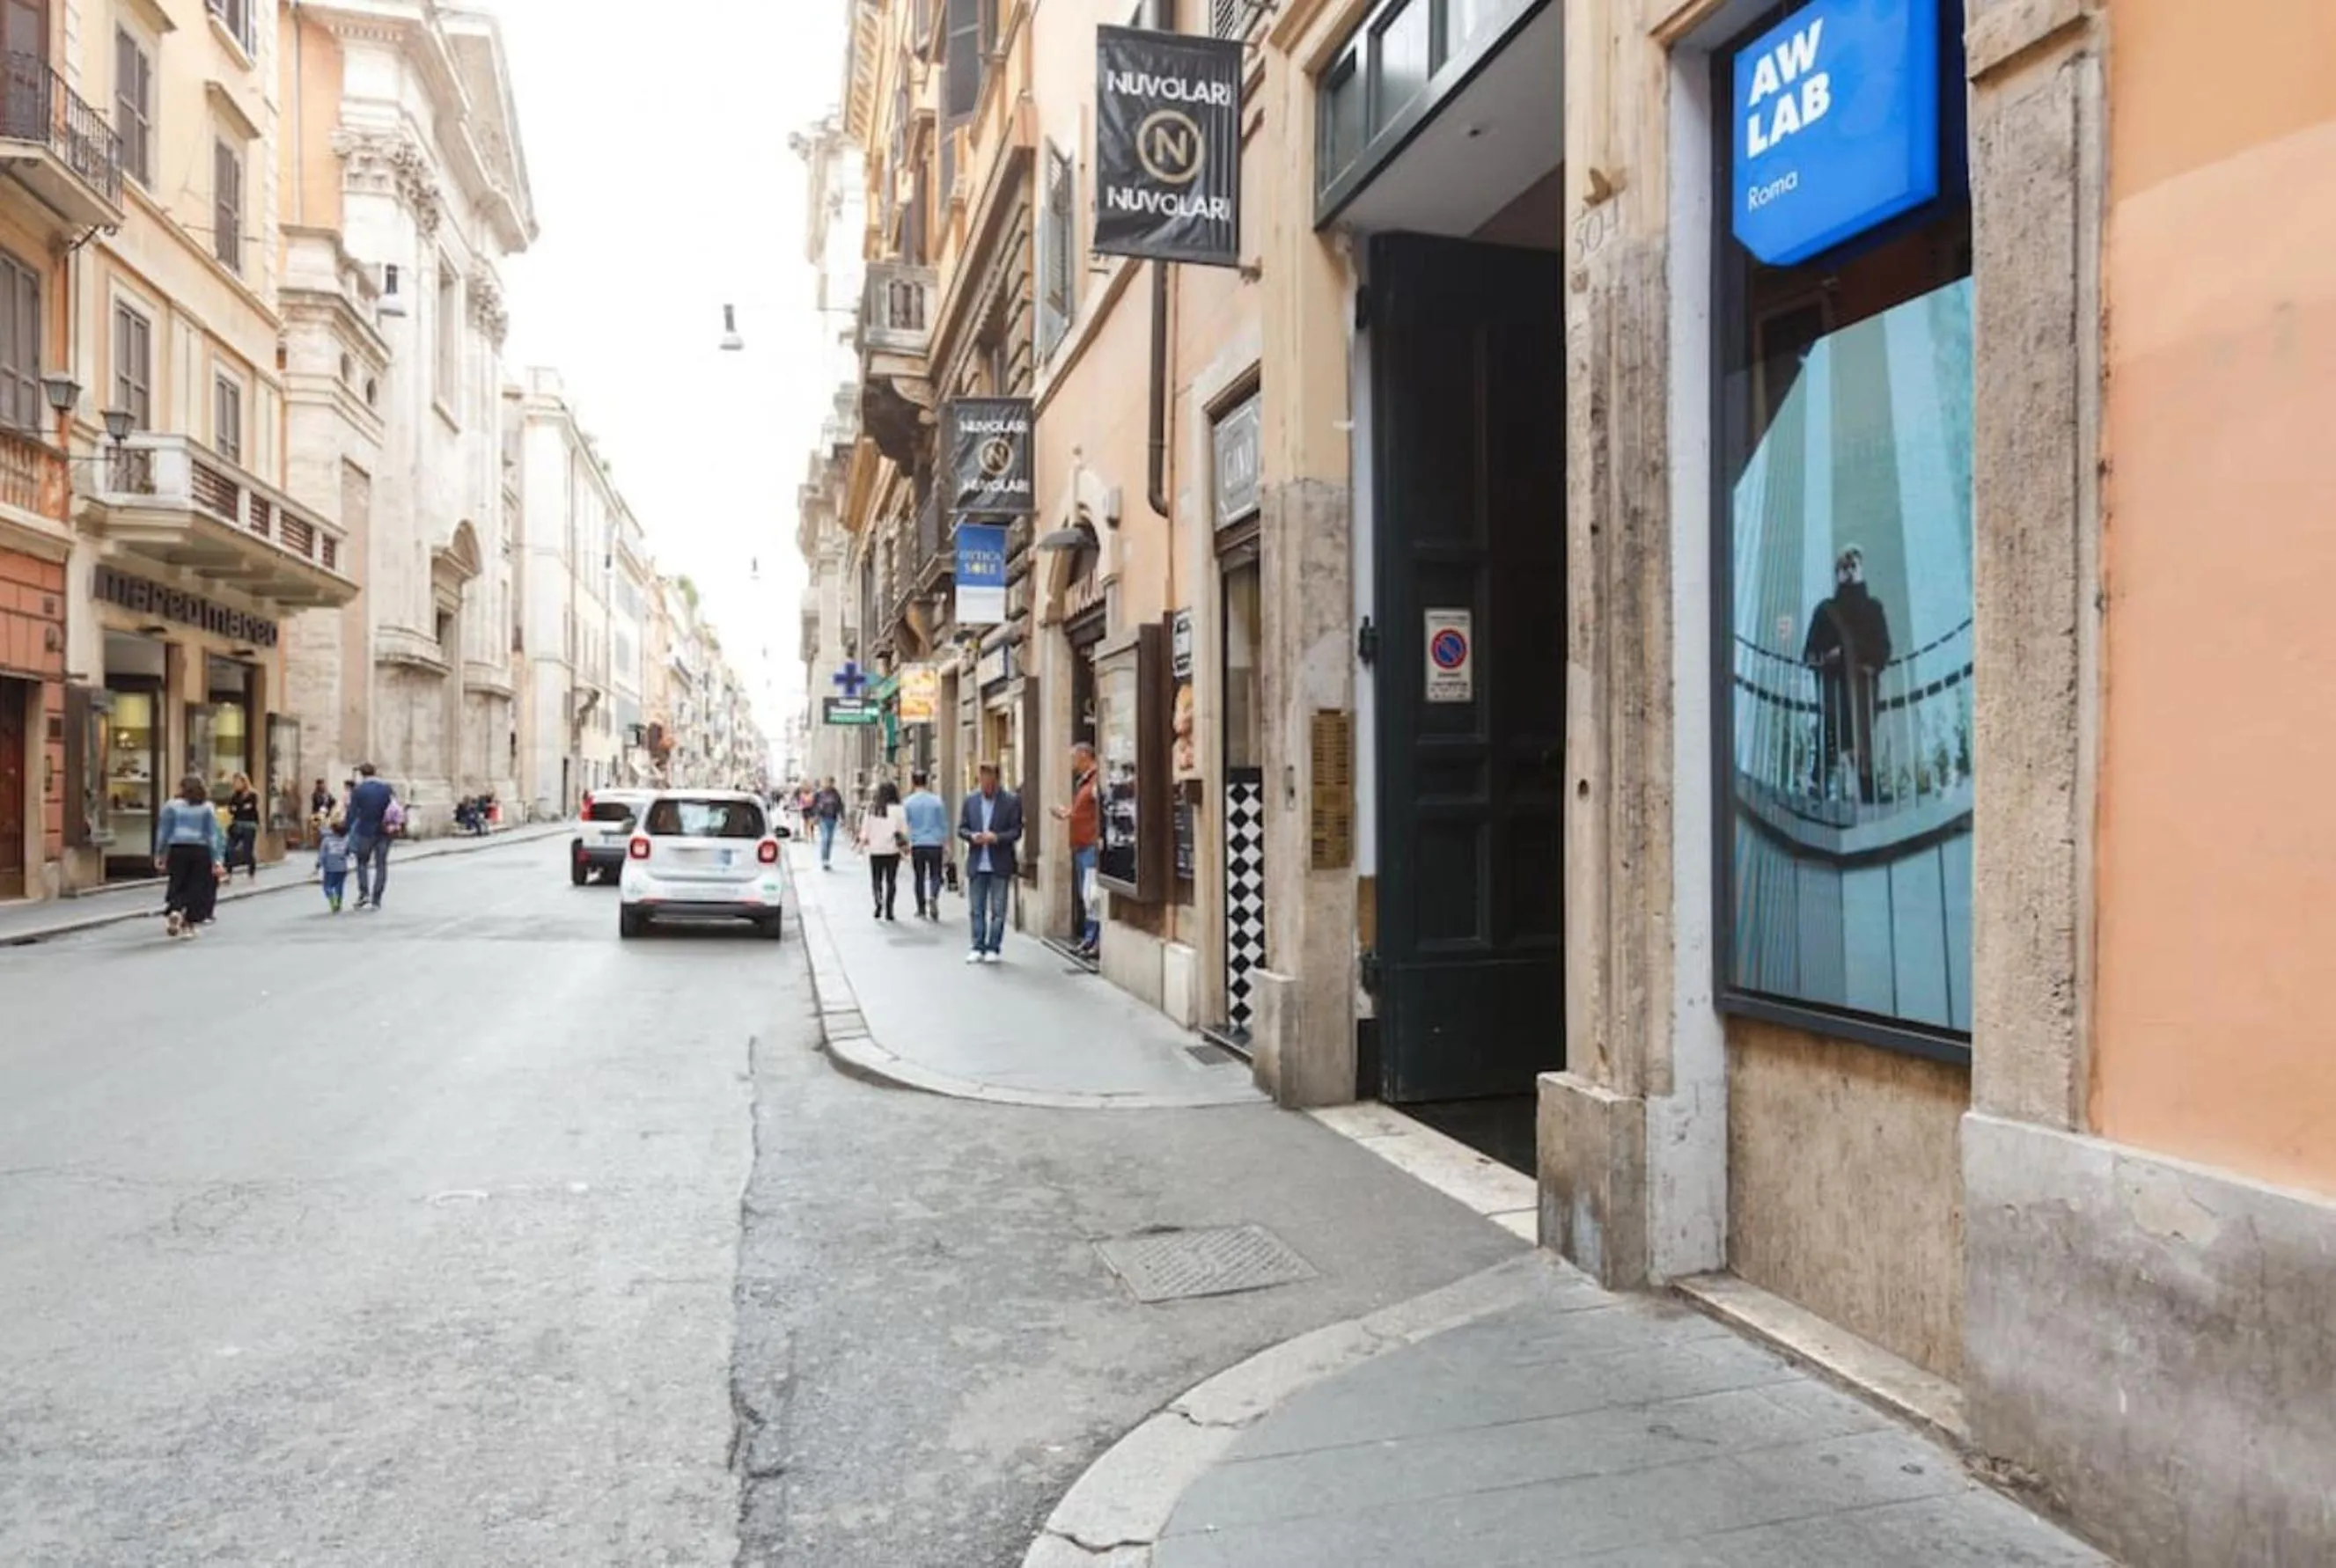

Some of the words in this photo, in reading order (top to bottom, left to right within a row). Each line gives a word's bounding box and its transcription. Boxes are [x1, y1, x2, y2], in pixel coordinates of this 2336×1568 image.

[1748, 16, 1824, 107] AW
[1106, 69, 1232, 106] NUVOLARI
[1747, 71, 1831, 159] LAB
[1106, 186, 1231, 221] NUVOLARI
[1748, 171, 1798, 212] Roma
